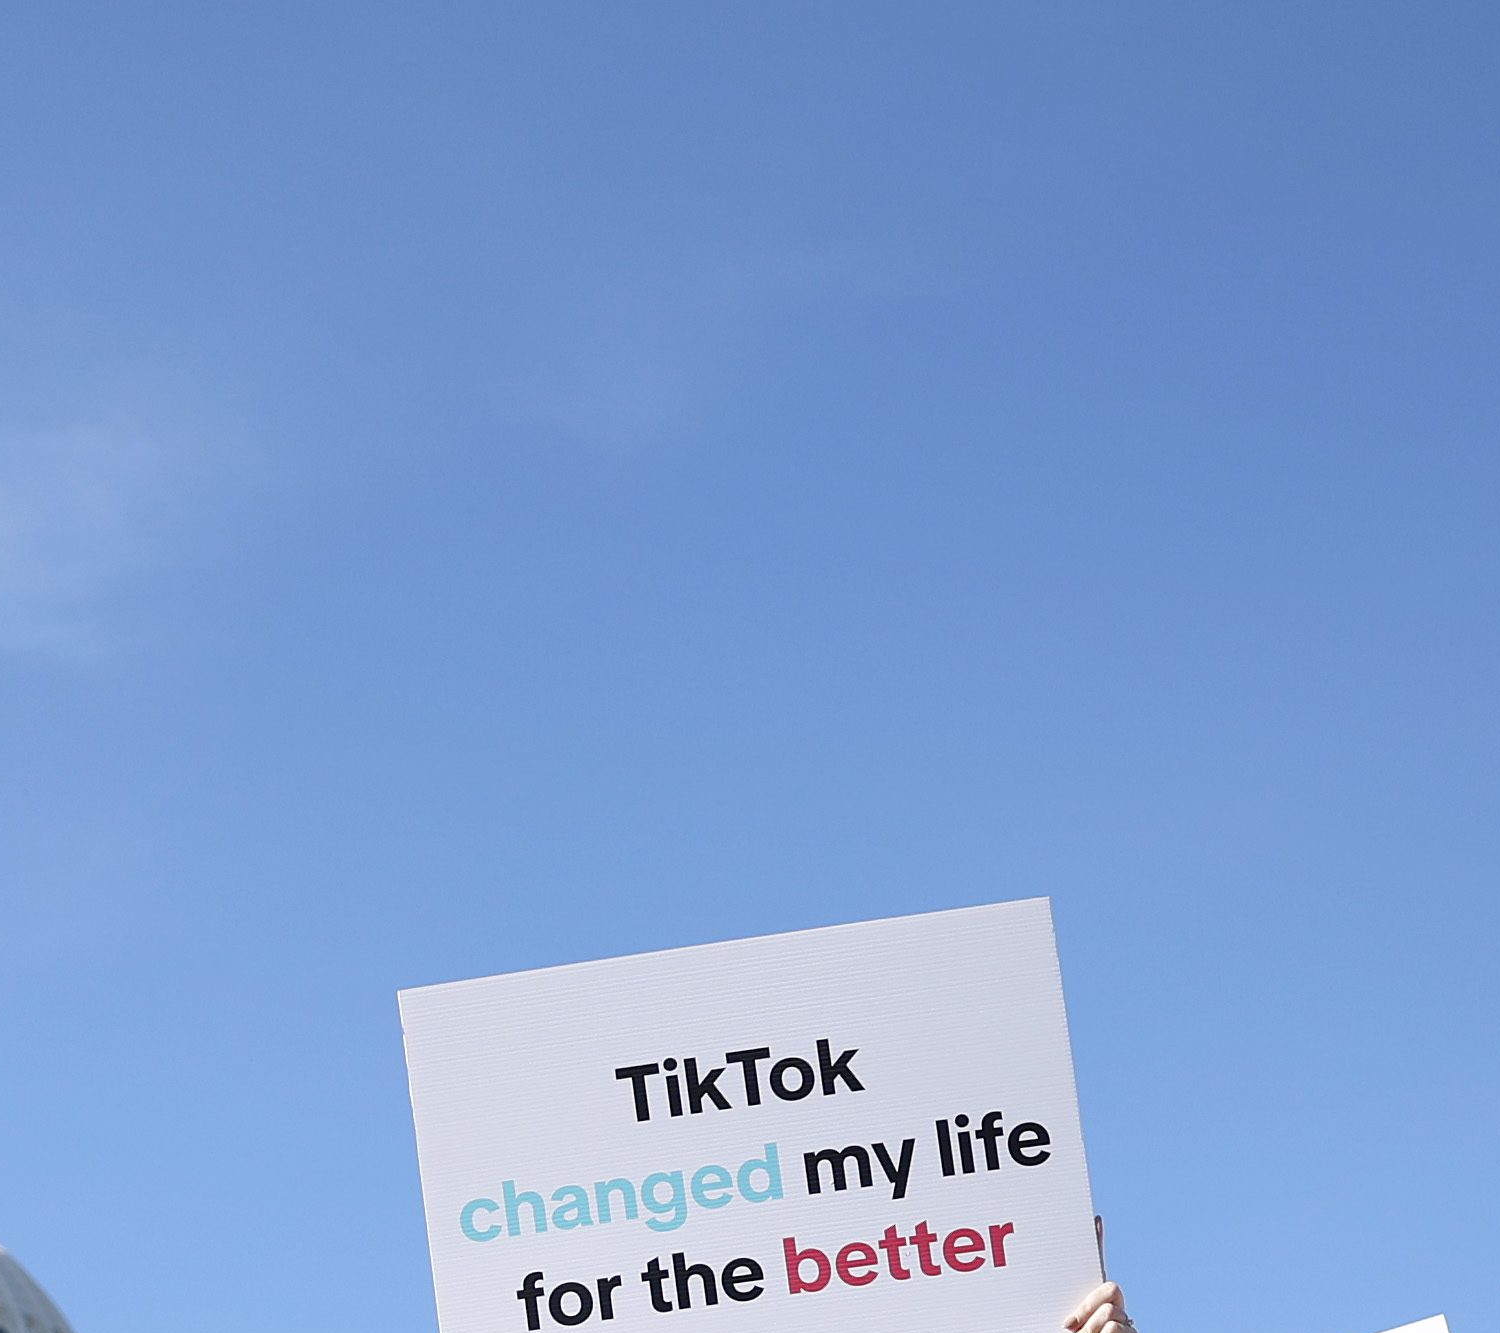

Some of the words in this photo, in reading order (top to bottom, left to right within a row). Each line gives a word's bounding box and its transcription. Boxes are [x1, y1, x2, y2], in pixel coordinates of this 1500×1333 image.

[615, 1039, 865, 1122] TikTok
[460, 1142, 783, 1242] changed
[804, 1139, 915, 1199] my
[936, 1111, 1050, 1176] life
[517, 1272, 622, 1331] for
[641, 1252, 764, 1312] the
[783, 1221, 1014, 1294] better
